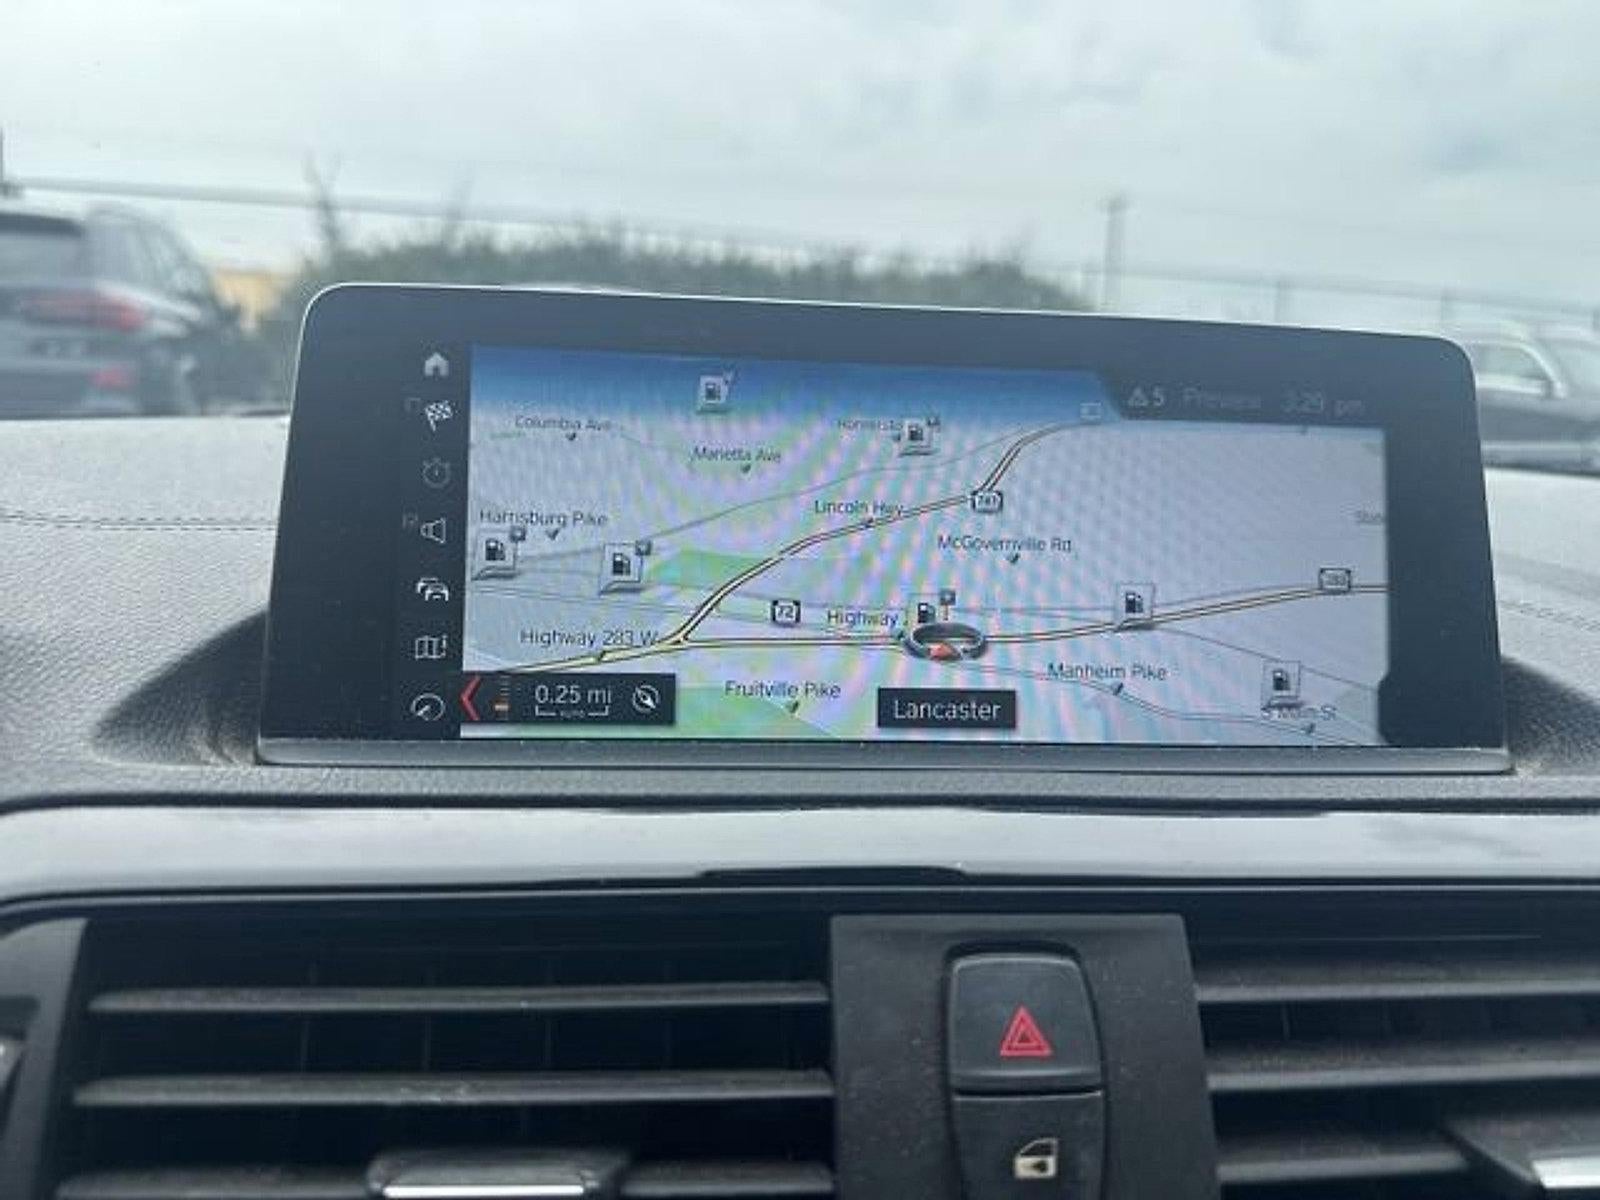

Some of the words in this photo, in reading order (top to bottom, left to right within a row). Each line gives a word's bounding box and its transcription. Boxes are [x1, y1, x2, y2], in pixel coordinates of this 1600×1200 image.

[514, 414, 582, 431] Columbia
[585, 416, 613, 431] Ave
[755, 448, 782, 463] Ave
[814, 499, 867, 515] Lincoln
[479, 508, 567, 528] Harrisburg
[572, 511, 608, 525] Pike
[774, 606, 795, 620] 72
[826, 609, 899, 627] Highway
[519, 629, 596, 647] Highway
[601, 630, 634, 645] 283
[1047, 662, 1126, 680] Manheim
[1130, 664, 1168, 681] Pike
[534, 685, 582, 704] 0.25
[587, 685, 612, 704] mi
[724, 680, 799, 698] Fruitville
[804, 683, 841, 699] Pike
[894, 699, 1002, 721] Lancaster
